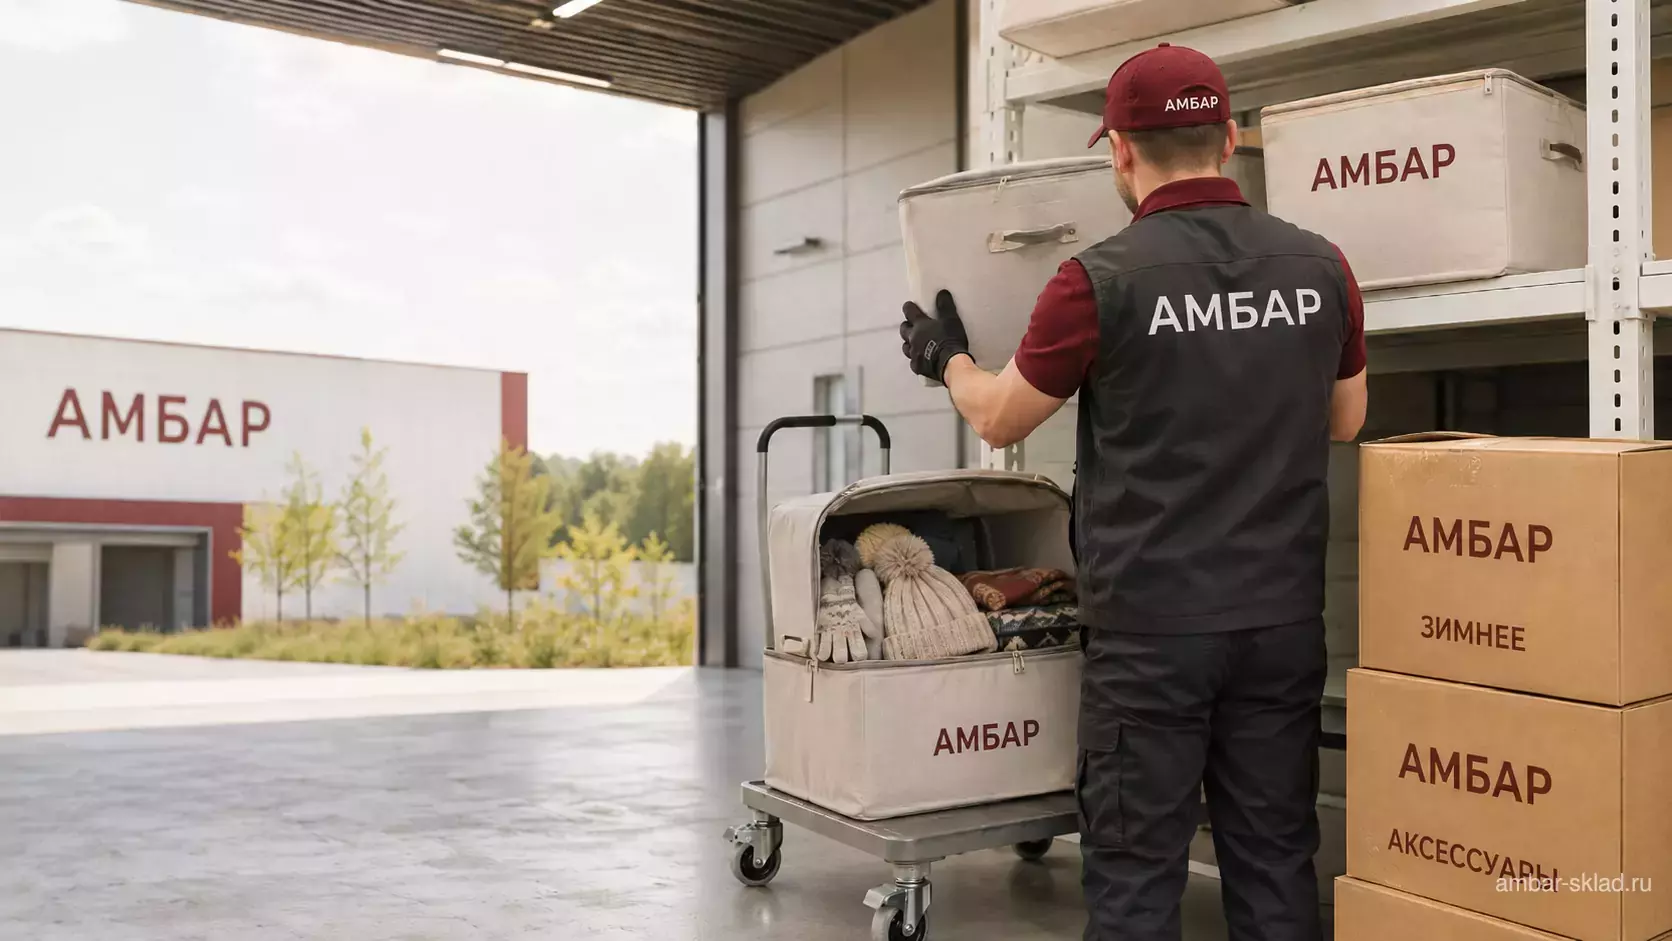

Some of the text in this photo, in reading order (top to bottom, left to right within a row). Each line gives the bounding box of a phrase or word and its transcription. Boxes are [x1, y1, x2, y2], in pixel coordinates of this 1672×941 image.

[1165, 96, 1219, 112] АМБАР
[1311, 144, 1456, 192] АМБАР
[1148, 288, 1322, 336] АМБАР
[48, 387, 272, 447] АМБАР
[1403, 515, 1553, 564] АМБАР
[1420, 615, 1526, 652] ЗИМНЕЕ
[934, 719, 1040, 757] АМБАР
[1399, 743, 1552, 805] АМБАР
[1388, 828, 1558, 892] АКСЕССУАРЫ
